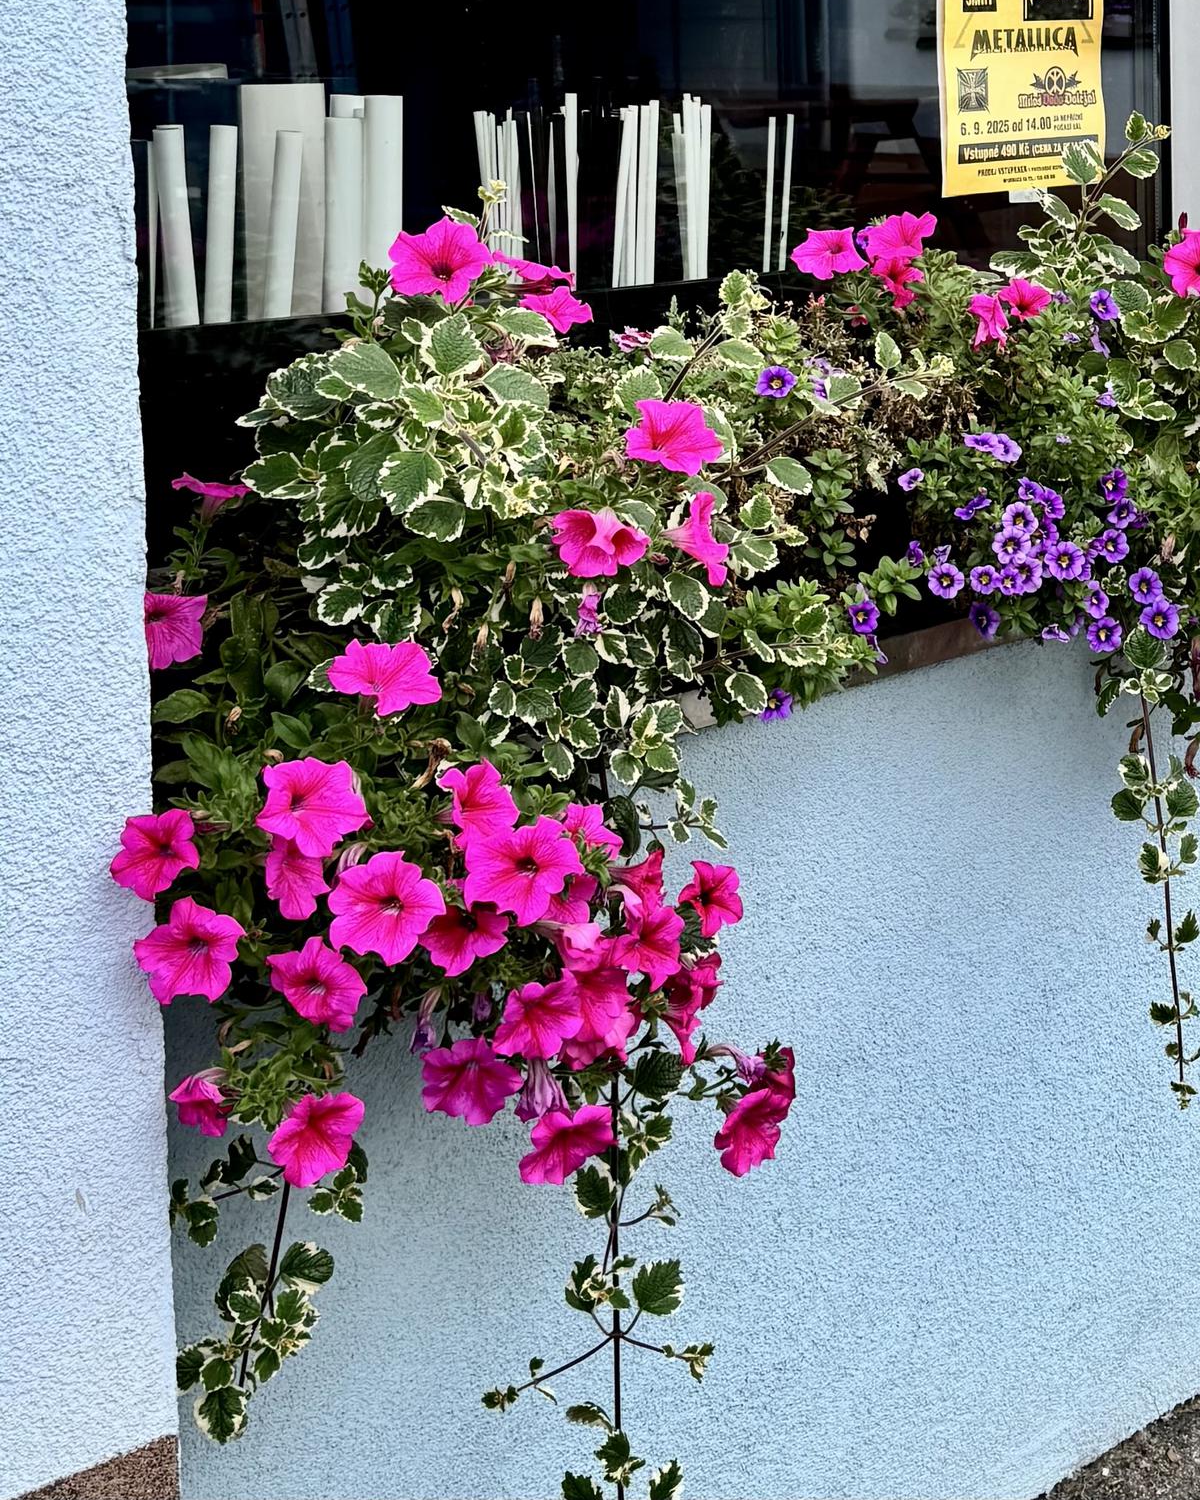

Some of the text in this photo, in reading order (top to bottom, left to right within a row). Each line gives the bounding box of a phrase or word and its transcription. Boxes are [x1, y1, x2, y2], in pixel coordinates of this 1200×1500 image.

[970, 27, 1079, 61] METALLICA
[960, 116, 1052, 136] 6. 9. 2025 od 14.00
[963, 145, 999, 161] Vstupné
[1001, 144, 1017, 157] 490
[1019, 142, 1030, 155] Kč
